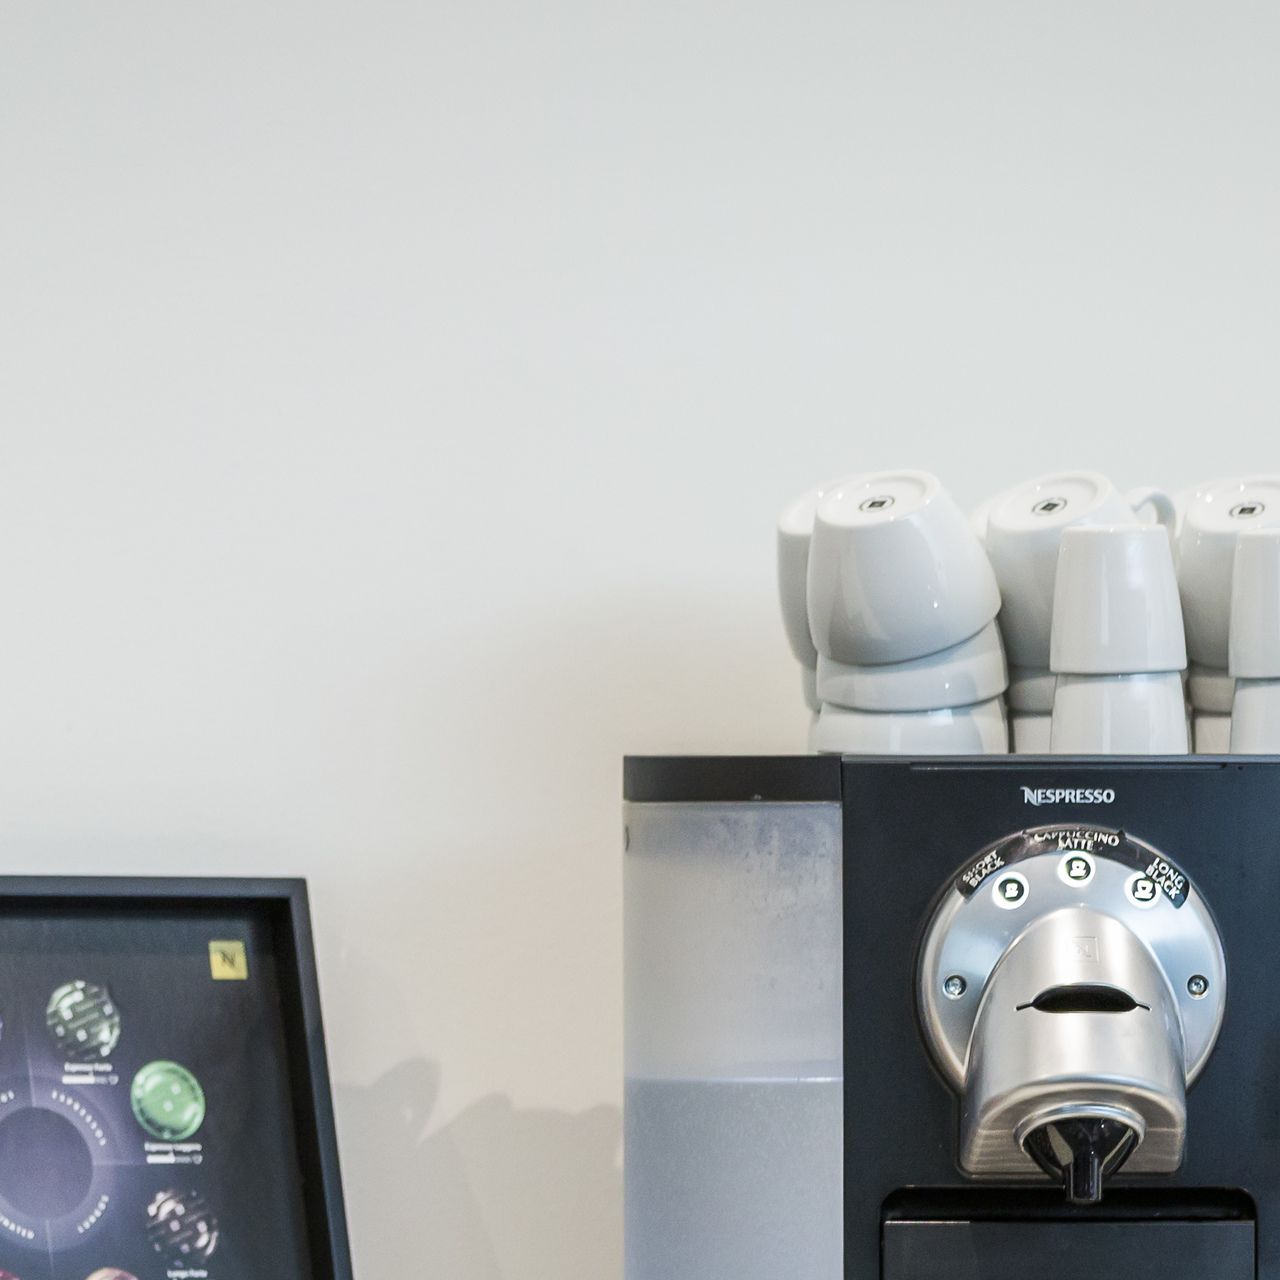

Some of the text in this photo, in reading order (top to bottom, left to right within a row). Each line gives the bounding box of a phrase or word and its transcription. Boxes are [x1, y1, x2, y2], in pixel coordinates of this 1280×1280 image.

[1021, 786, 1116, 806] NESPRESSO
[962, 850, 998, 883] SHORT
[969, 857, 1005, 888] BLACK
[1145, 865, 1182, 900] BLACK
[1153, 857, 1186, 890] LONG
